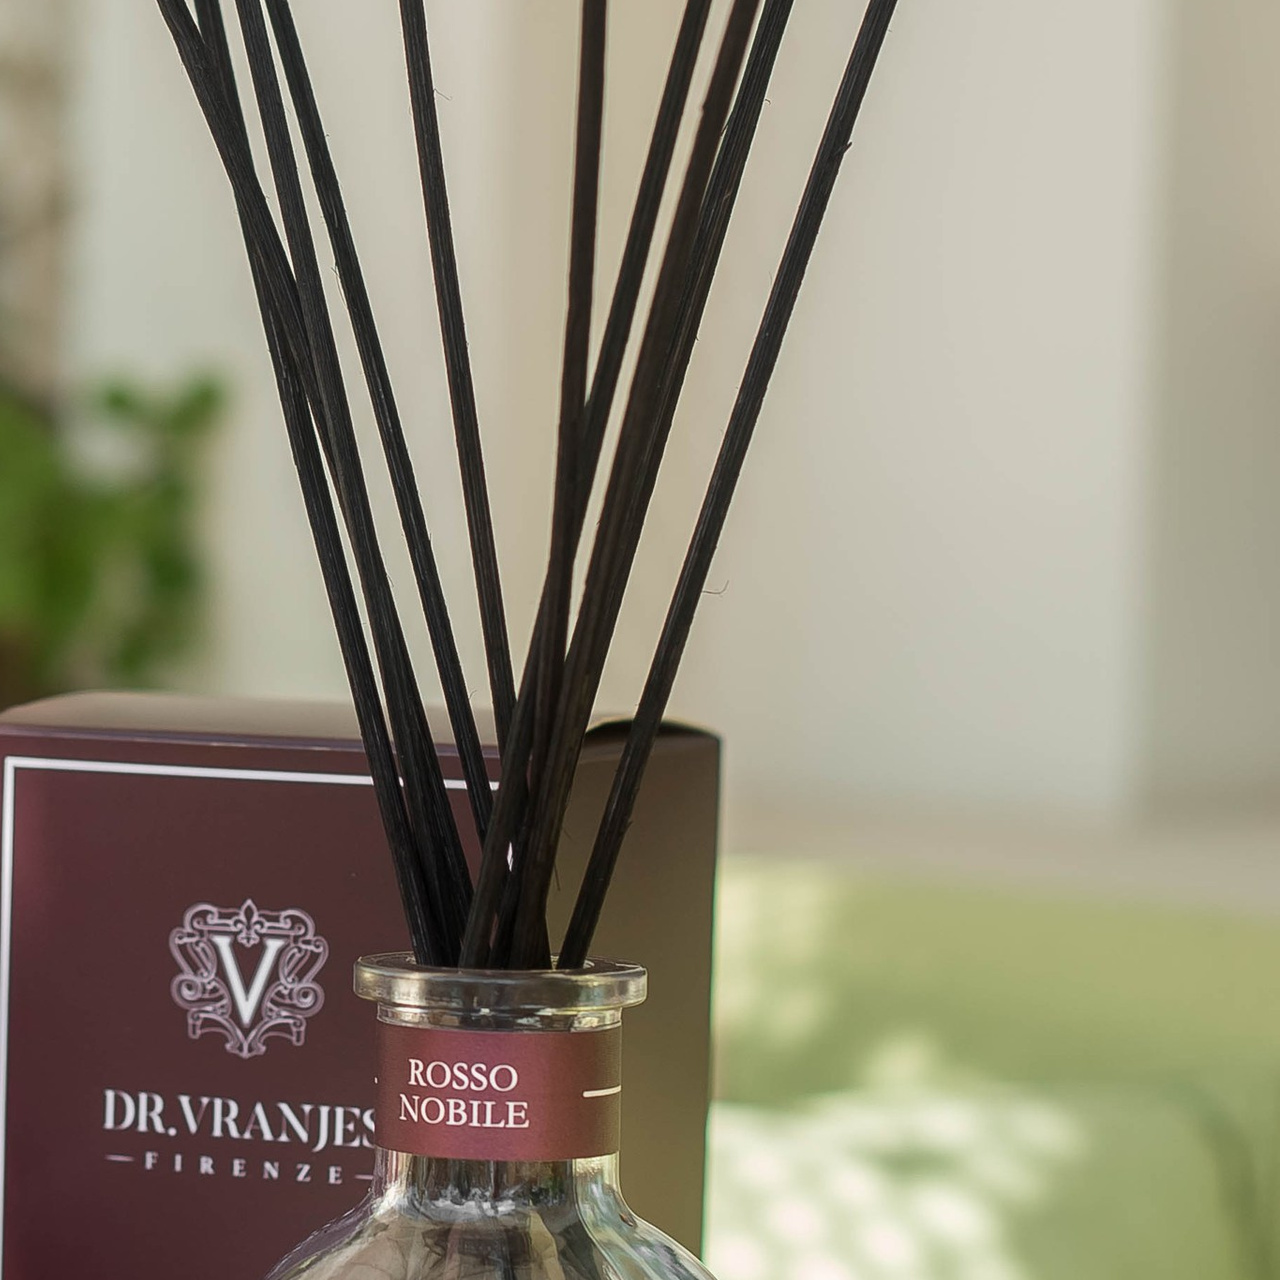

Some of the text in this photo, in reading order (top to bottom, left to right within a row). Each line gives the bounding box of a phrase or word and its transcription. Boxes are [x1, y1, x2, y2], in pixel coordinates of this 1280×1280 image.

[407, 1058, 519, 1092] ROSSO
[398, 1093, 530, 1128] NOBILE
[144, 1150, 344, 1185] FIRENZE
